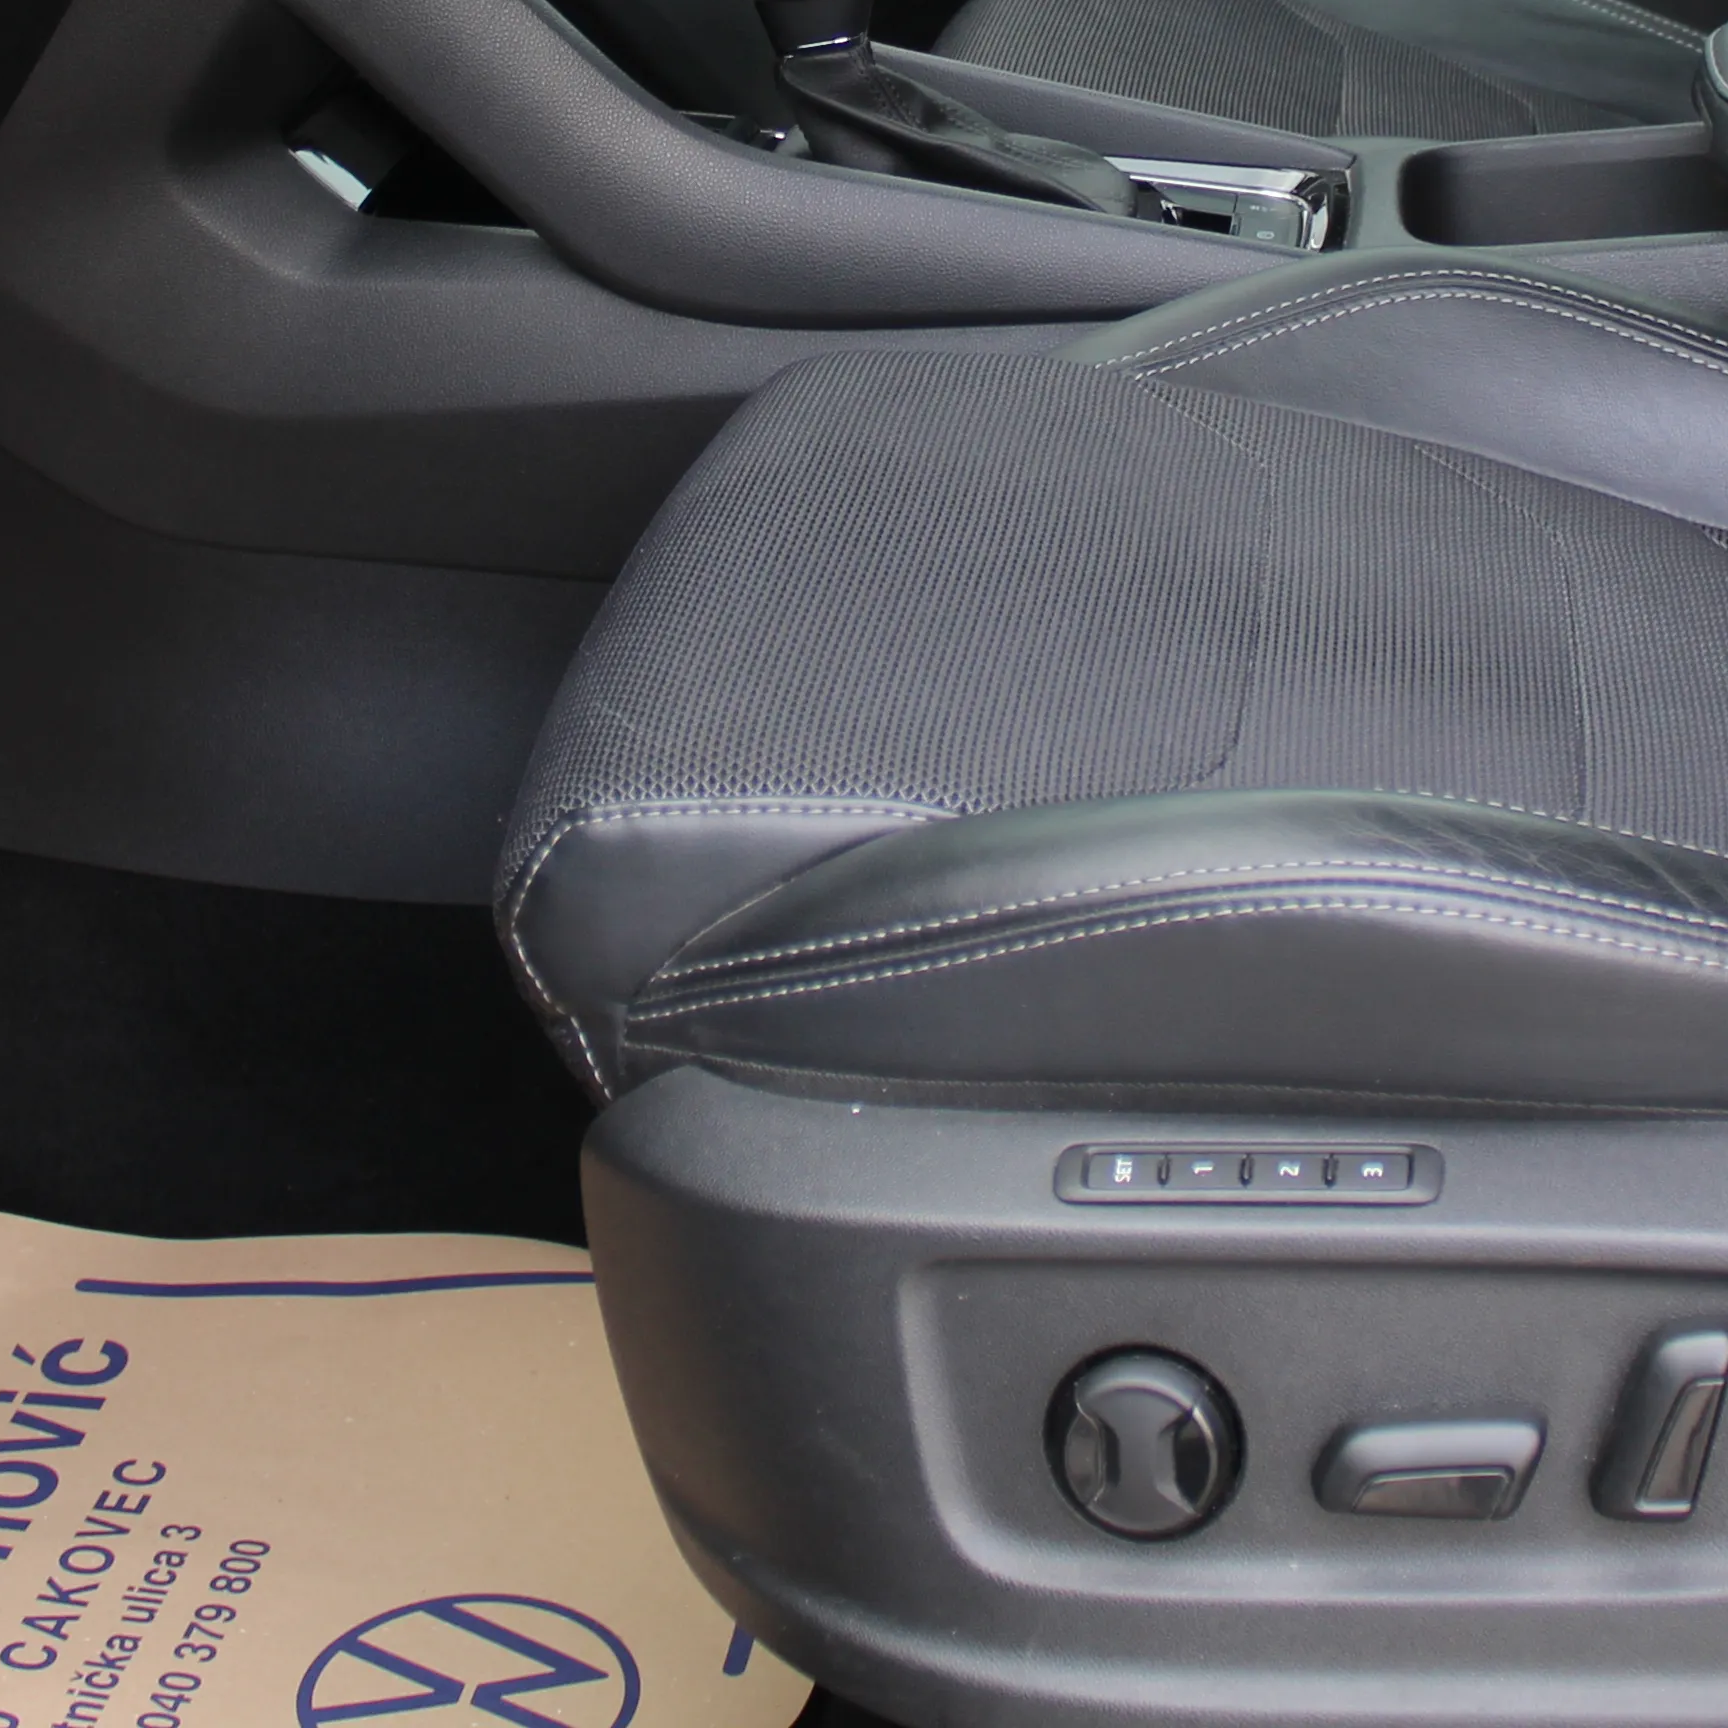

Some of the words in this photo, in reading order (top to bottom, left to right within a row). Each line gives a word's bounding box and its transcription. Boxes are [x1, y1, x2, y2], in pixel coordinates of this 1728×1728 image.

[1114, 1155, 1134, 1183] SET
[1192, 1160, 1214, 1174] 1
[1279, 1161, 1301, 1177] 2
[1362, 1162, 1384, 1178] 3
[121, 1549, 190, 1623] ulica
[160, 1524, 202, 1542] 3
[136, 1671, 202, 1728] 040
[173, 1604, 237, 1663] 379
[209, 1539, 271, 1594] 800
